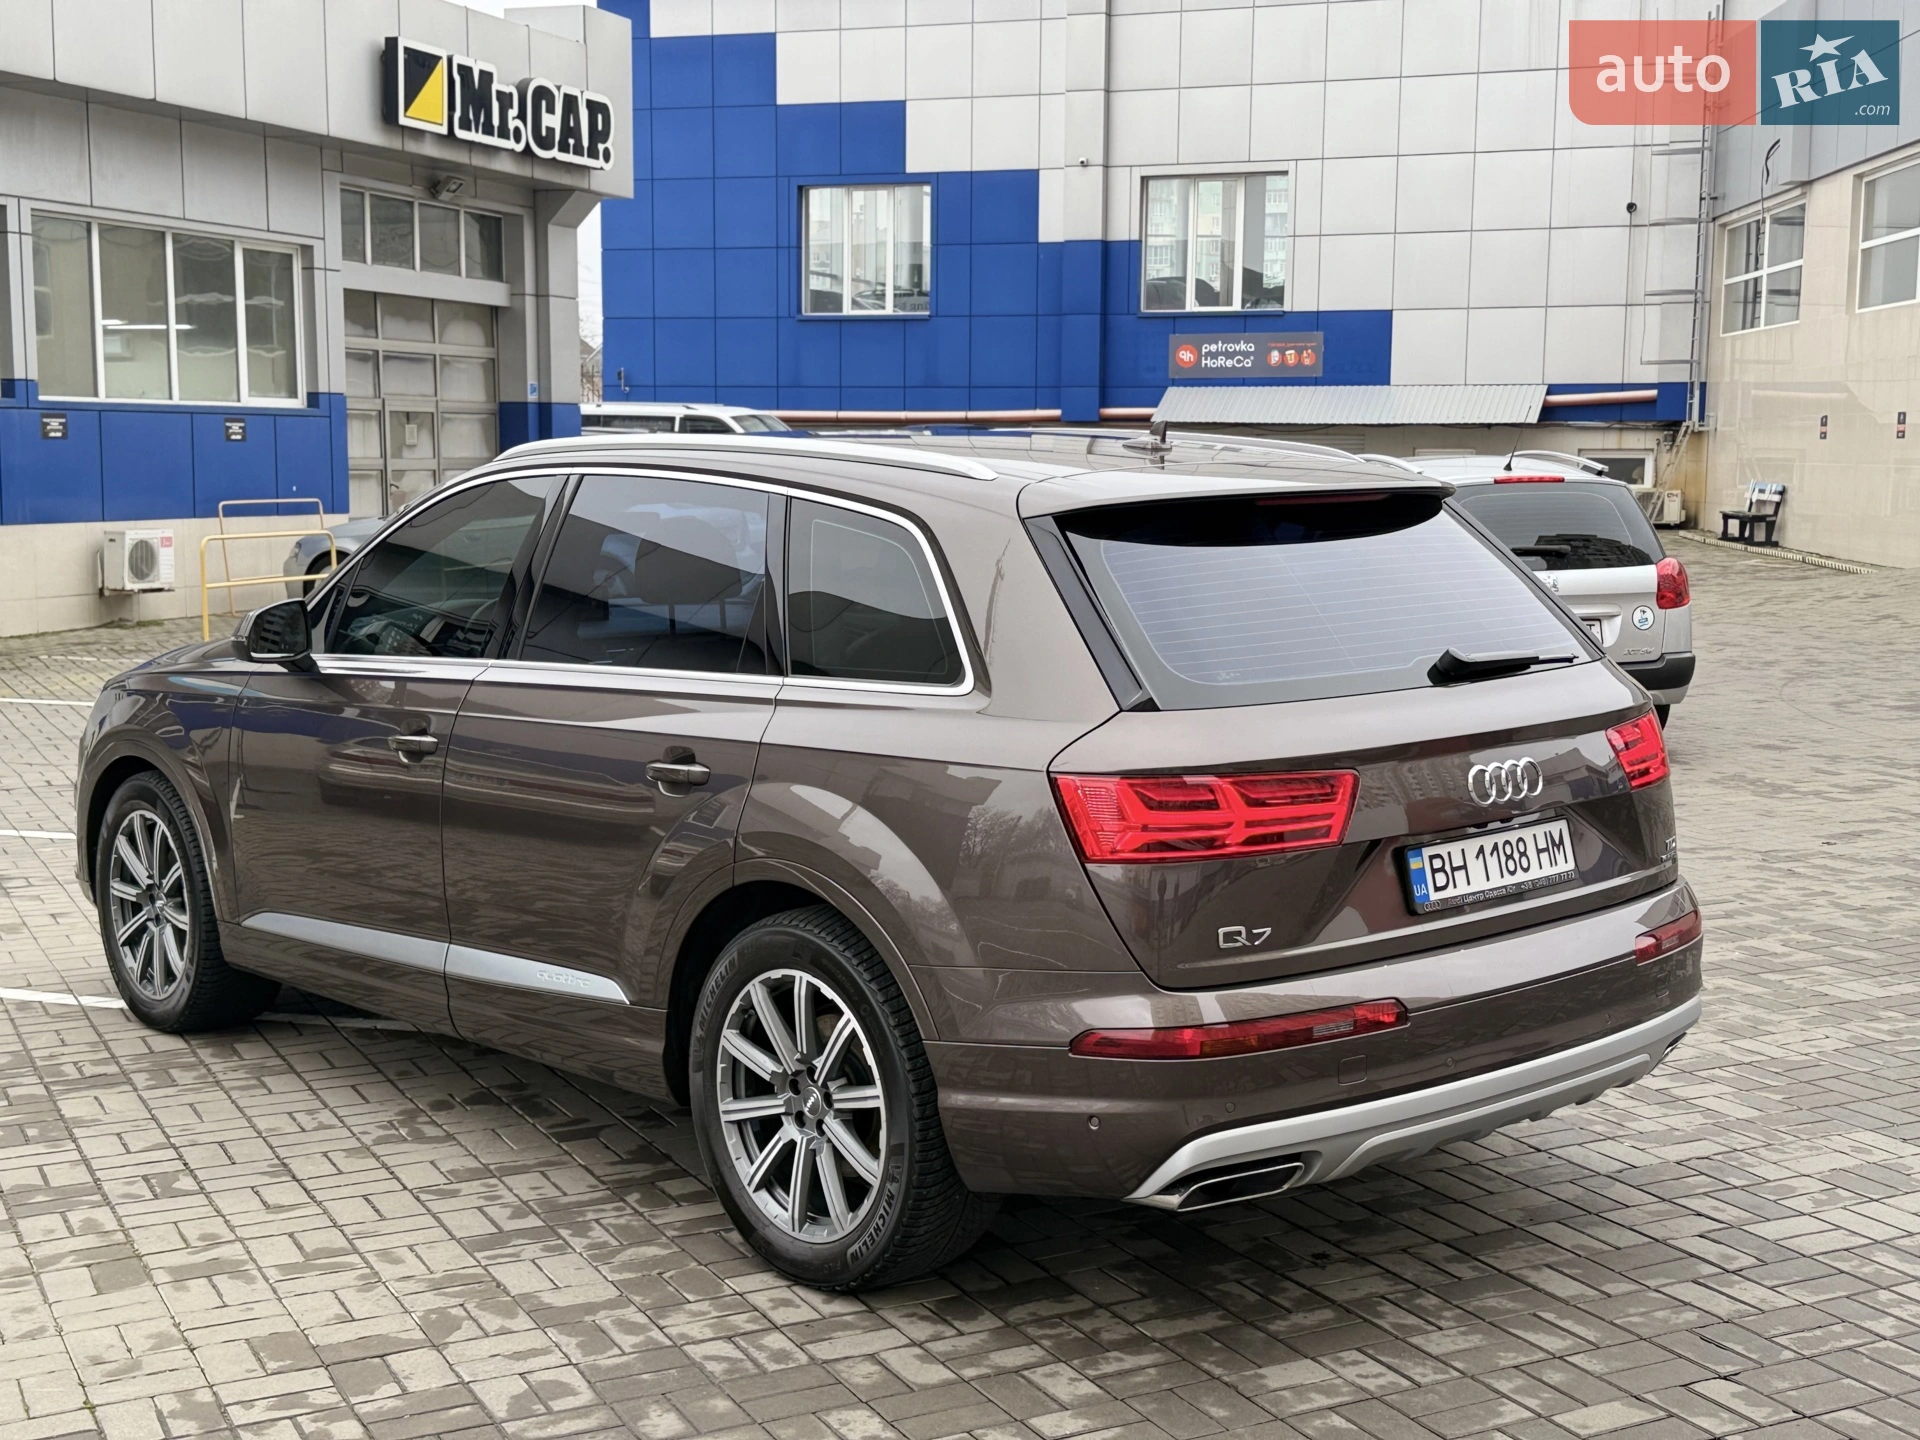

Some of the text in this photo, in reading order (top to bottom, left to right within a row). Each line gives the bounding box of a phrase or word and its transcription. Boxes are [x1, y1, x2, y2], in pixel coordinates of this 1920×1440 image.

[1201, 340, 1255, 356] petrovka
[1428, 828, 1568, 893] BH 1188 HM
[1413, 884, 1428, 896] UA
[1217, 925, 1272, 949] Q7
[536, 969, 591, 988] quattro
[697, 955, 738, 1031] MICHELIN
[850, 1187, 895, 1265] MICHELIN
